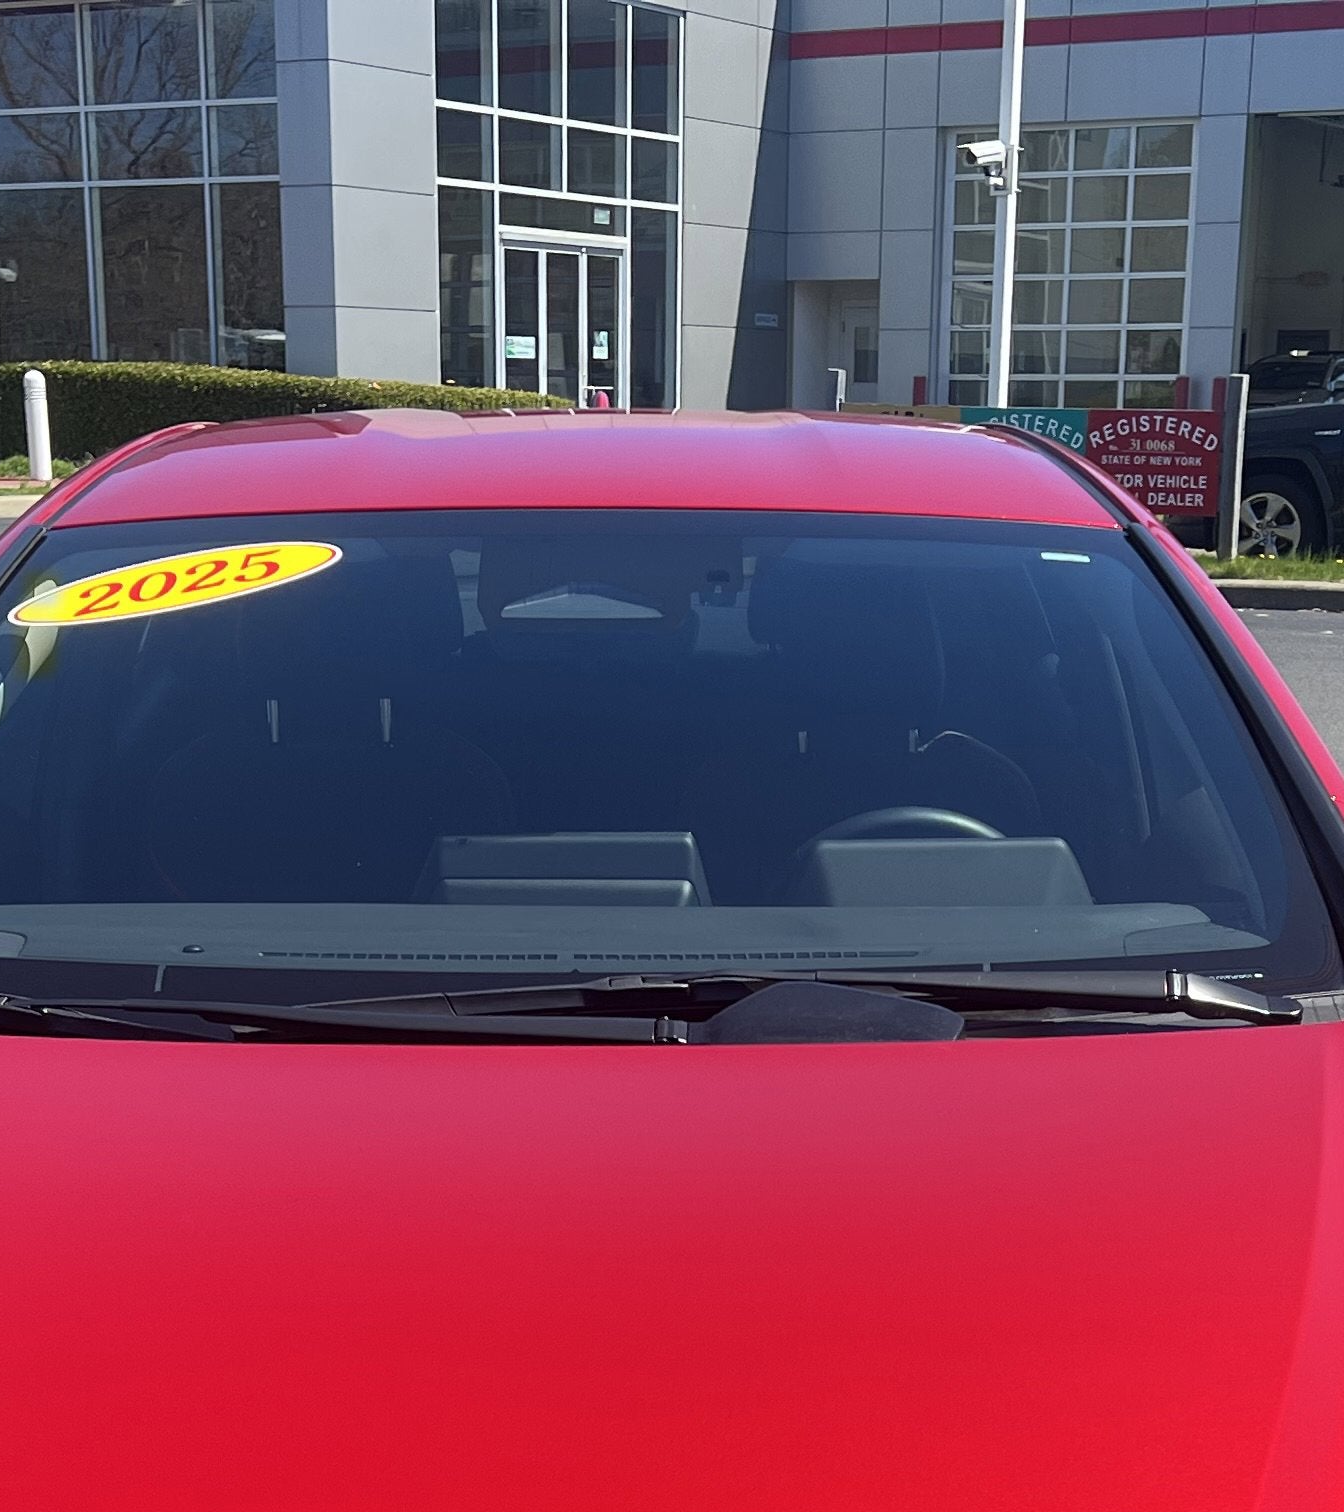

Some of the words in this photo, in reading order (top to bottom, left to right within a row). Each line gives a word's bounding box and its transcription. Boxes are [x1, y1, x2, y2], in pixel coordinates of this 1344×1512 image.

[990, 413, 1084, 449] ISTERED
[1088, 415, 1219, 451] REGISTERED
[1129, 438, 1141, 451] 31
[1101, 454, 1131, 465] STATE
[1133, 455, 1148, 465] OF
[1149, 455, 1173, 466] NEW
[1174, 456, 1203, 467] YORK
[1114, 473, 1144, 489] TOR
[1147, 474, 1208, 489] VEHICLE
[1147, 492, 1204, 507] DEALER
[73, 550, 281, 617] 2025
